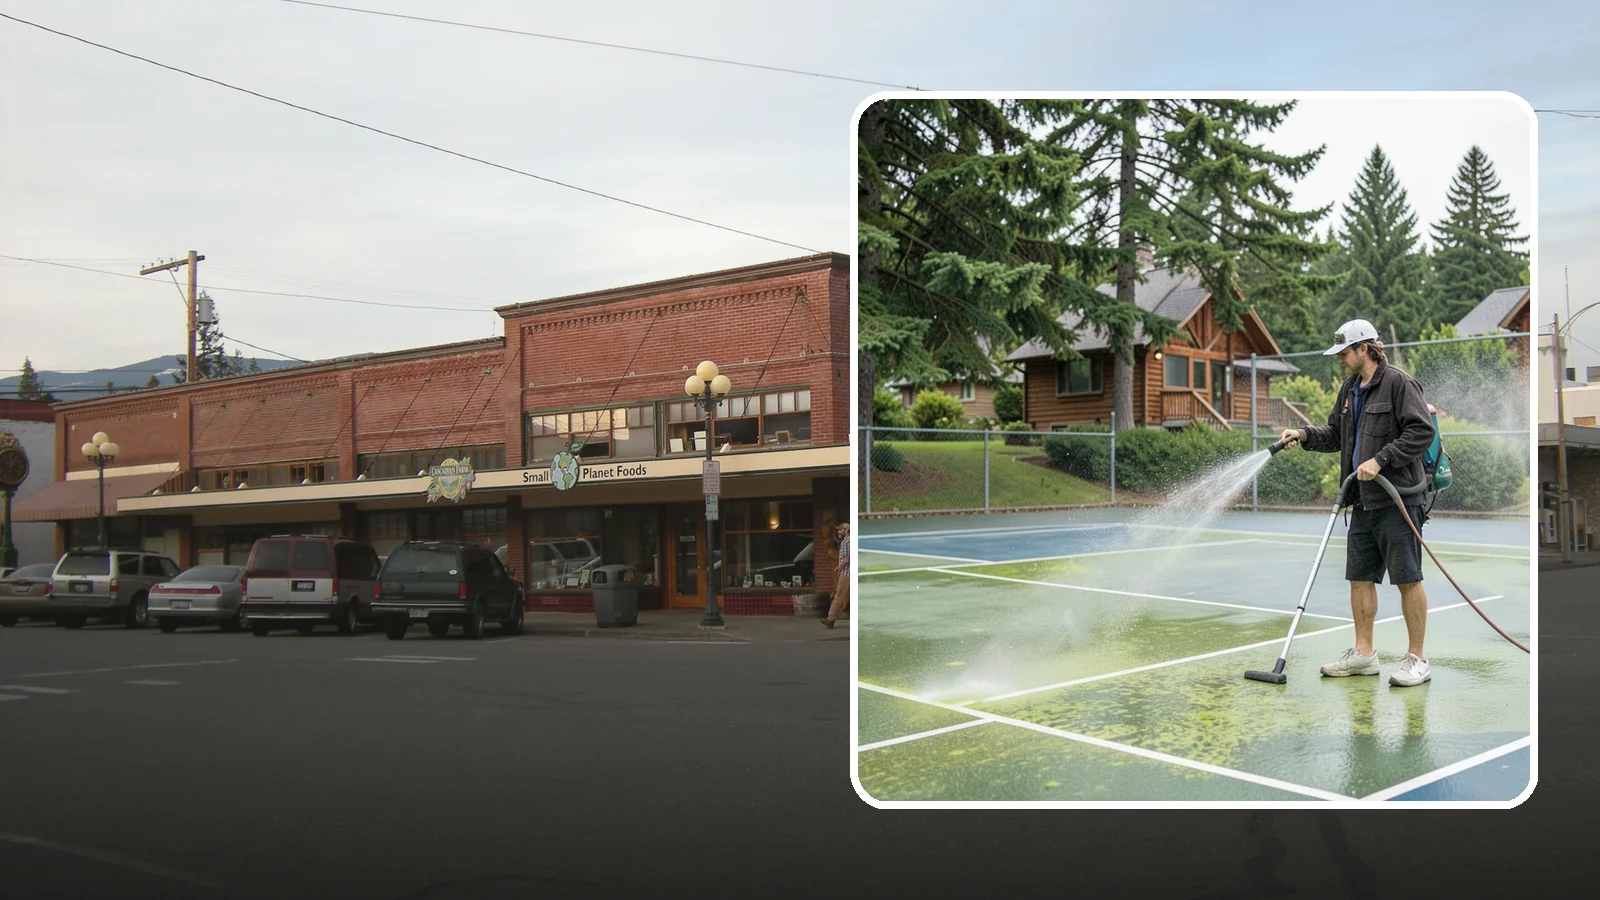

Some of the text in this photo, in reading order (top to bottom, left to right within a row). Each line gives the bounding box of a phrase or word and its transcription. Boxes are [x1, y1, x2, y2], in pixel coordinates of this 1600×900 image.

[523, 464, 647, 483] Small Planet Foods
